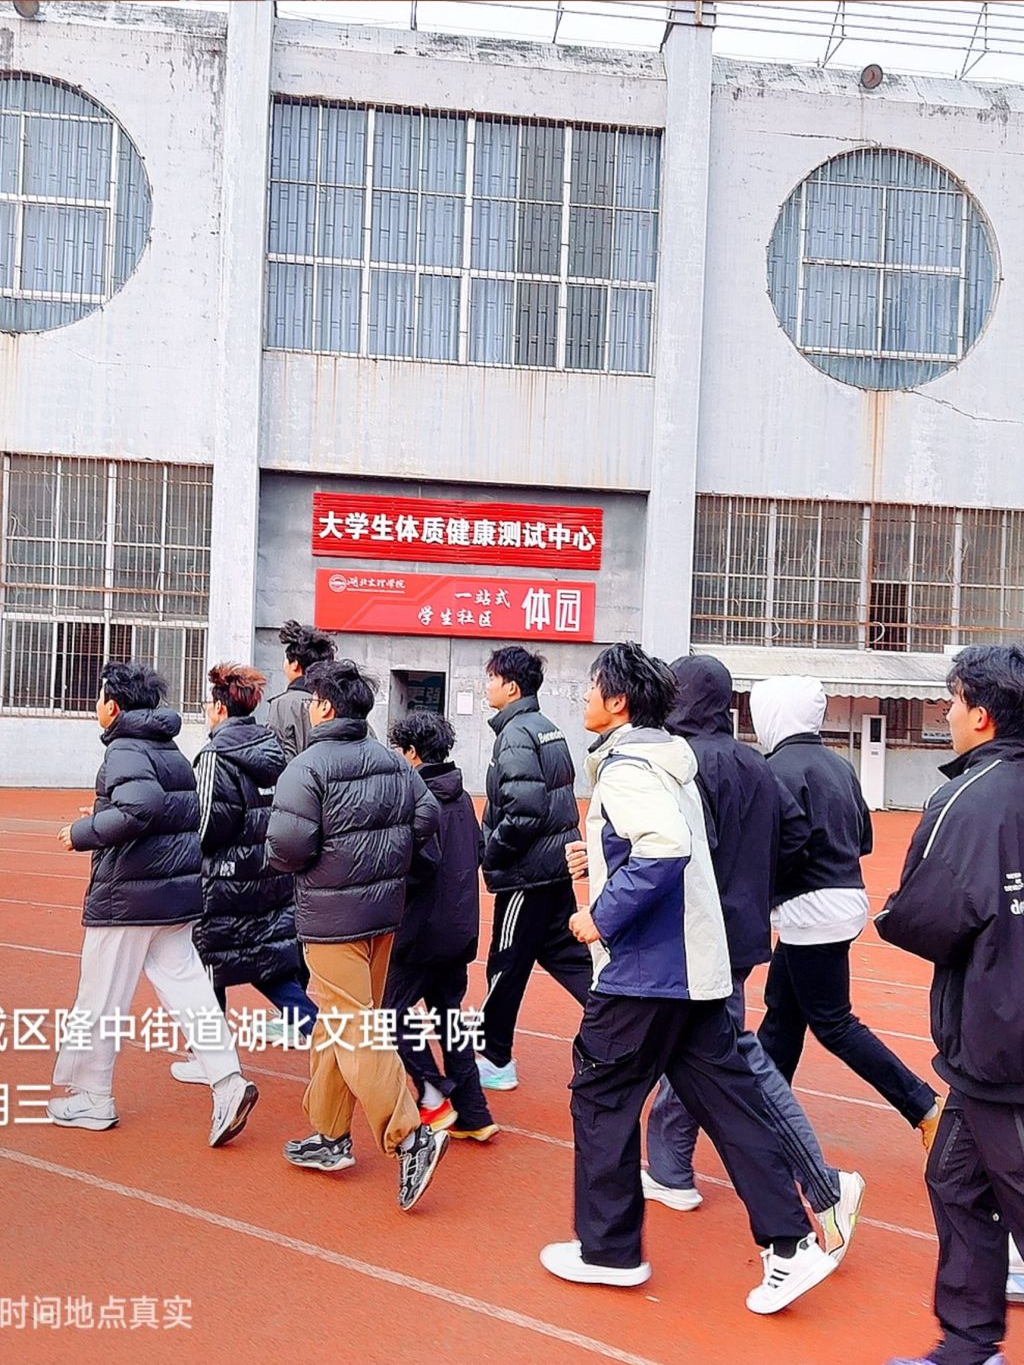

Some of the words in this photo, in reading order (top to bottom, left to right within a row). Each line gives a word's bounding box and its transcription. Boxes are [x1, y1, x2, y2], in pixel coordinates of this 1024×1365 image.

[318, 510, 596, 551] 大学生体质健康测试中心
[454, 588, 511, 609] 一站式
[521, 587, 581, 632] 体园
[417, 604, 493, 628] 学生社区
